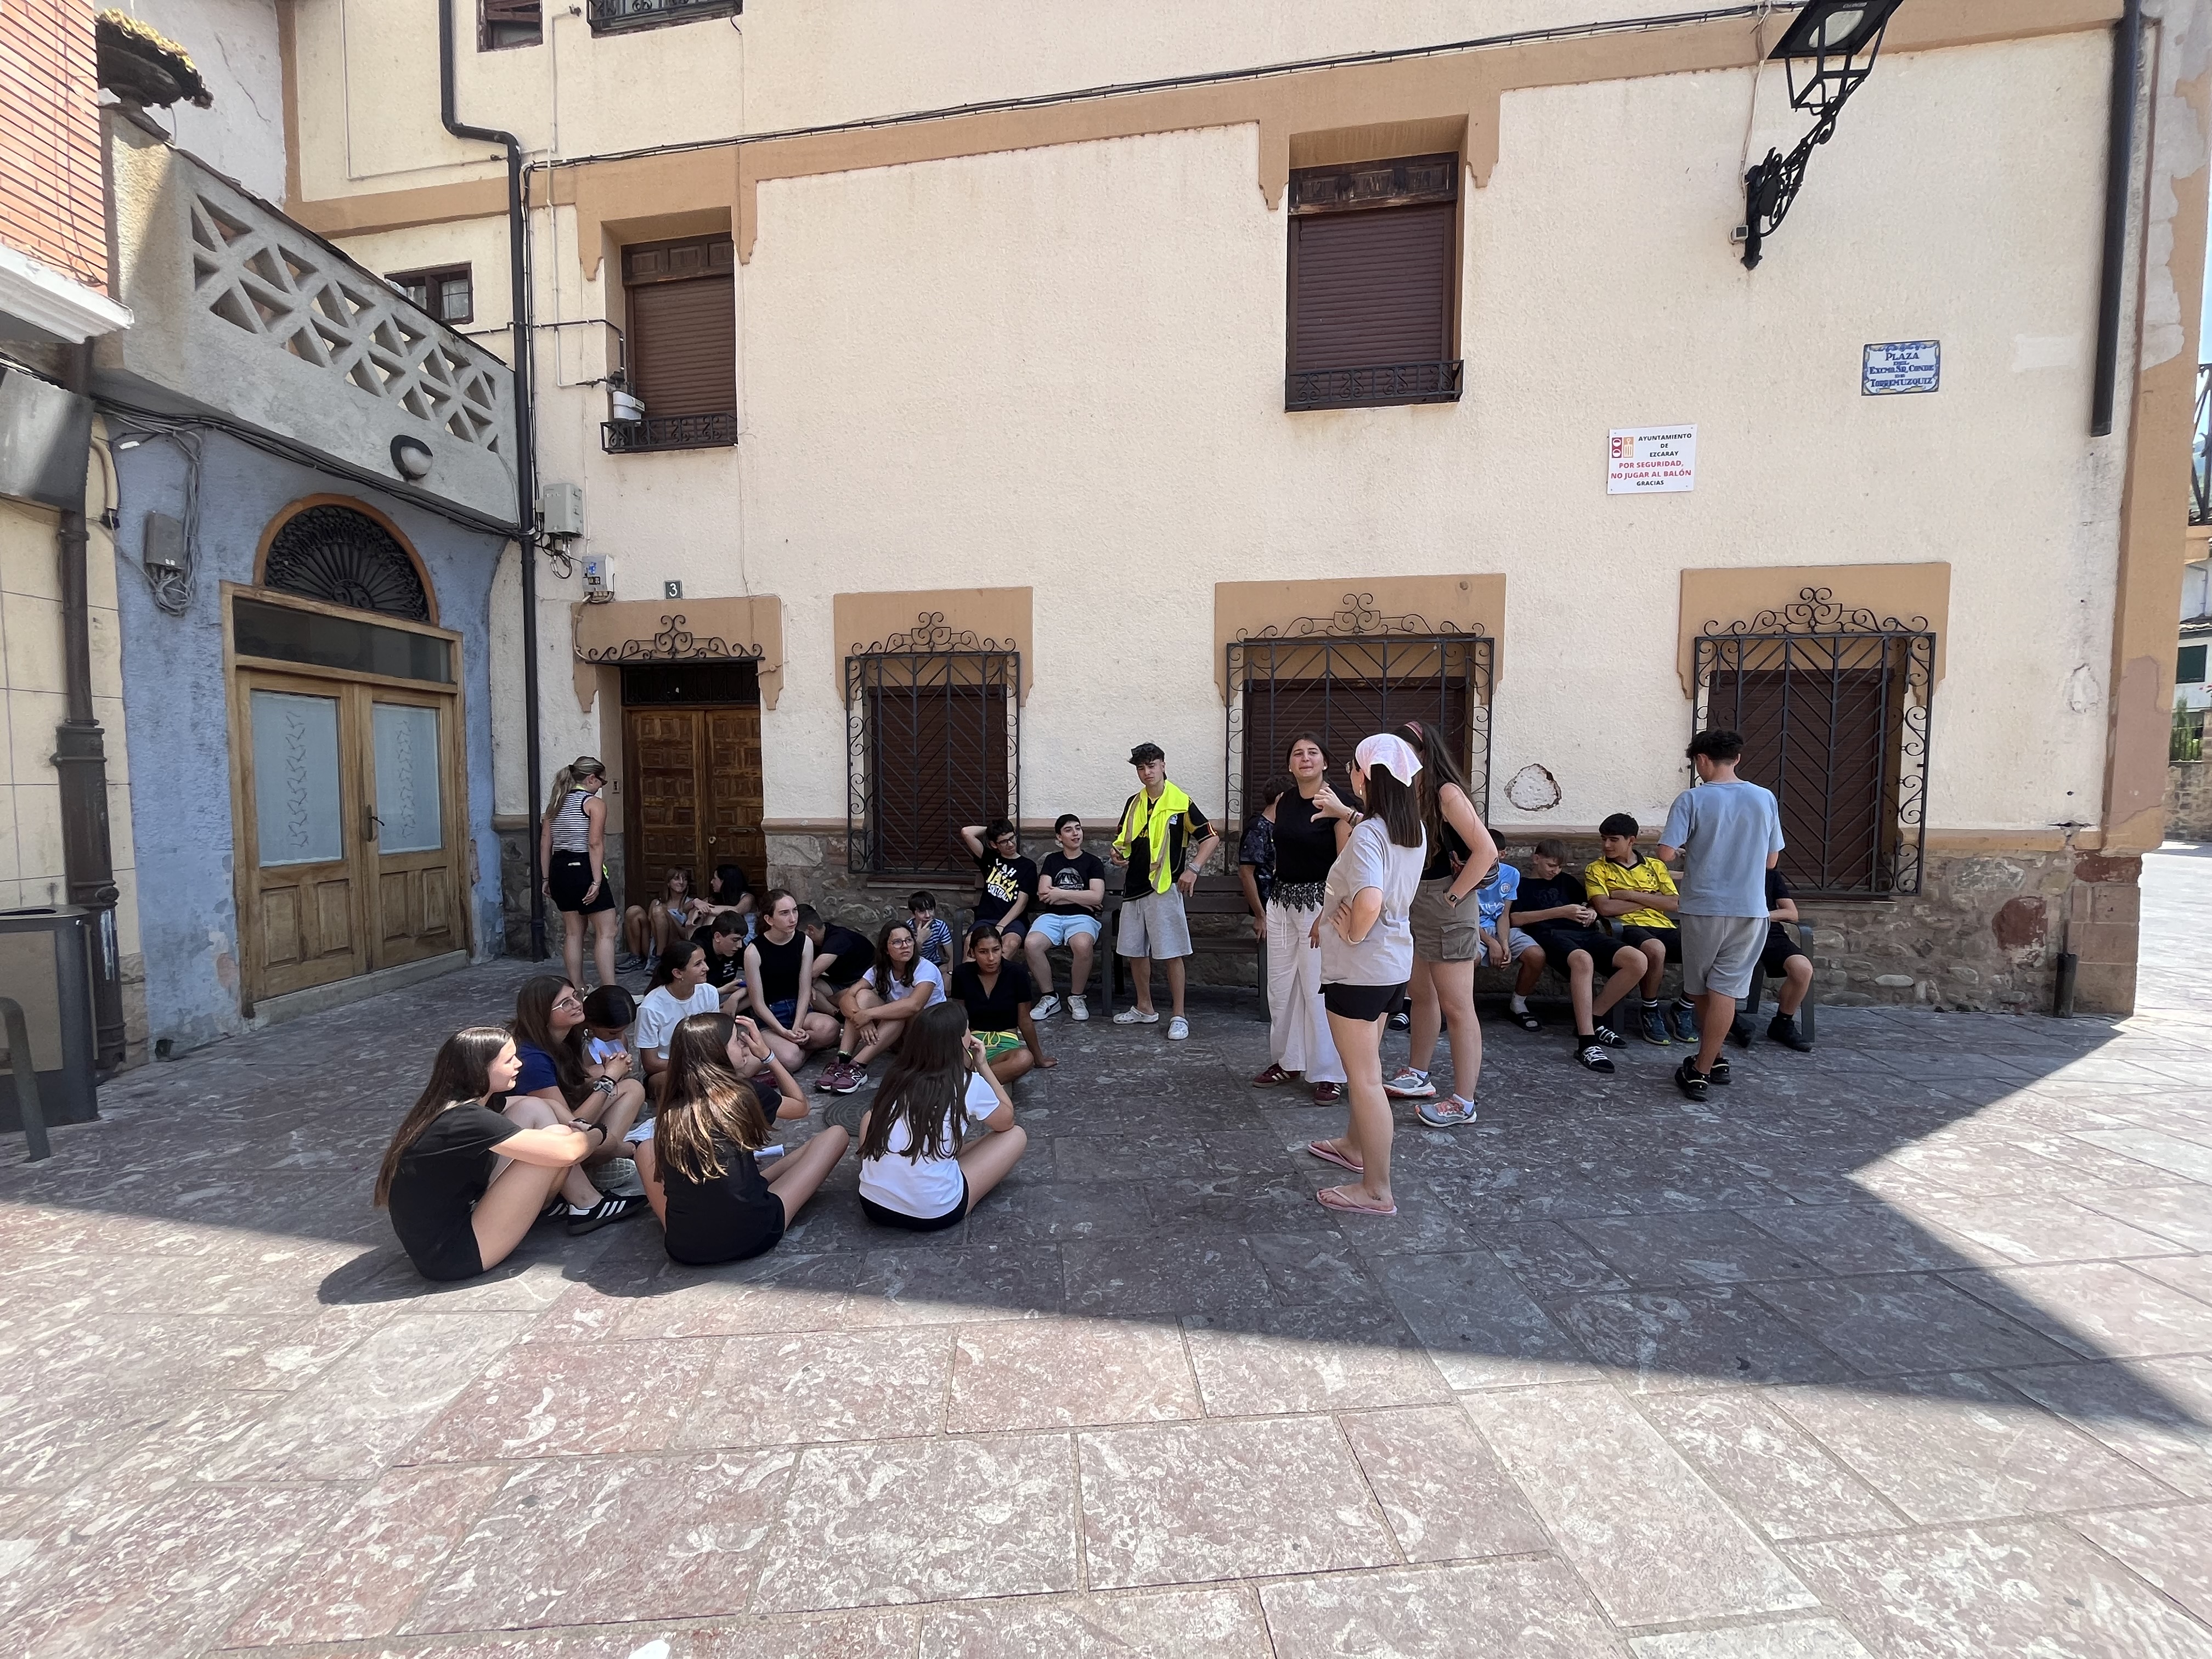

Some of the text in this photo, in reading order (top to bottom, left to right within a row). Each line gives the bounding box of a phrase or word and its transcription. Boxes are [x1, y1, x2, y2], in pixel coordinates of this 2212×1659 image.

[1886, 352, 1920, 361] PLAZA
[1638, 433, 1692, 442] AYUNTAMIENTO
[1624, 472, 1650, 480] JUGAR
[1663, 469, 1691, 477] BALÓN
[669, 583, 678, 597] 3
